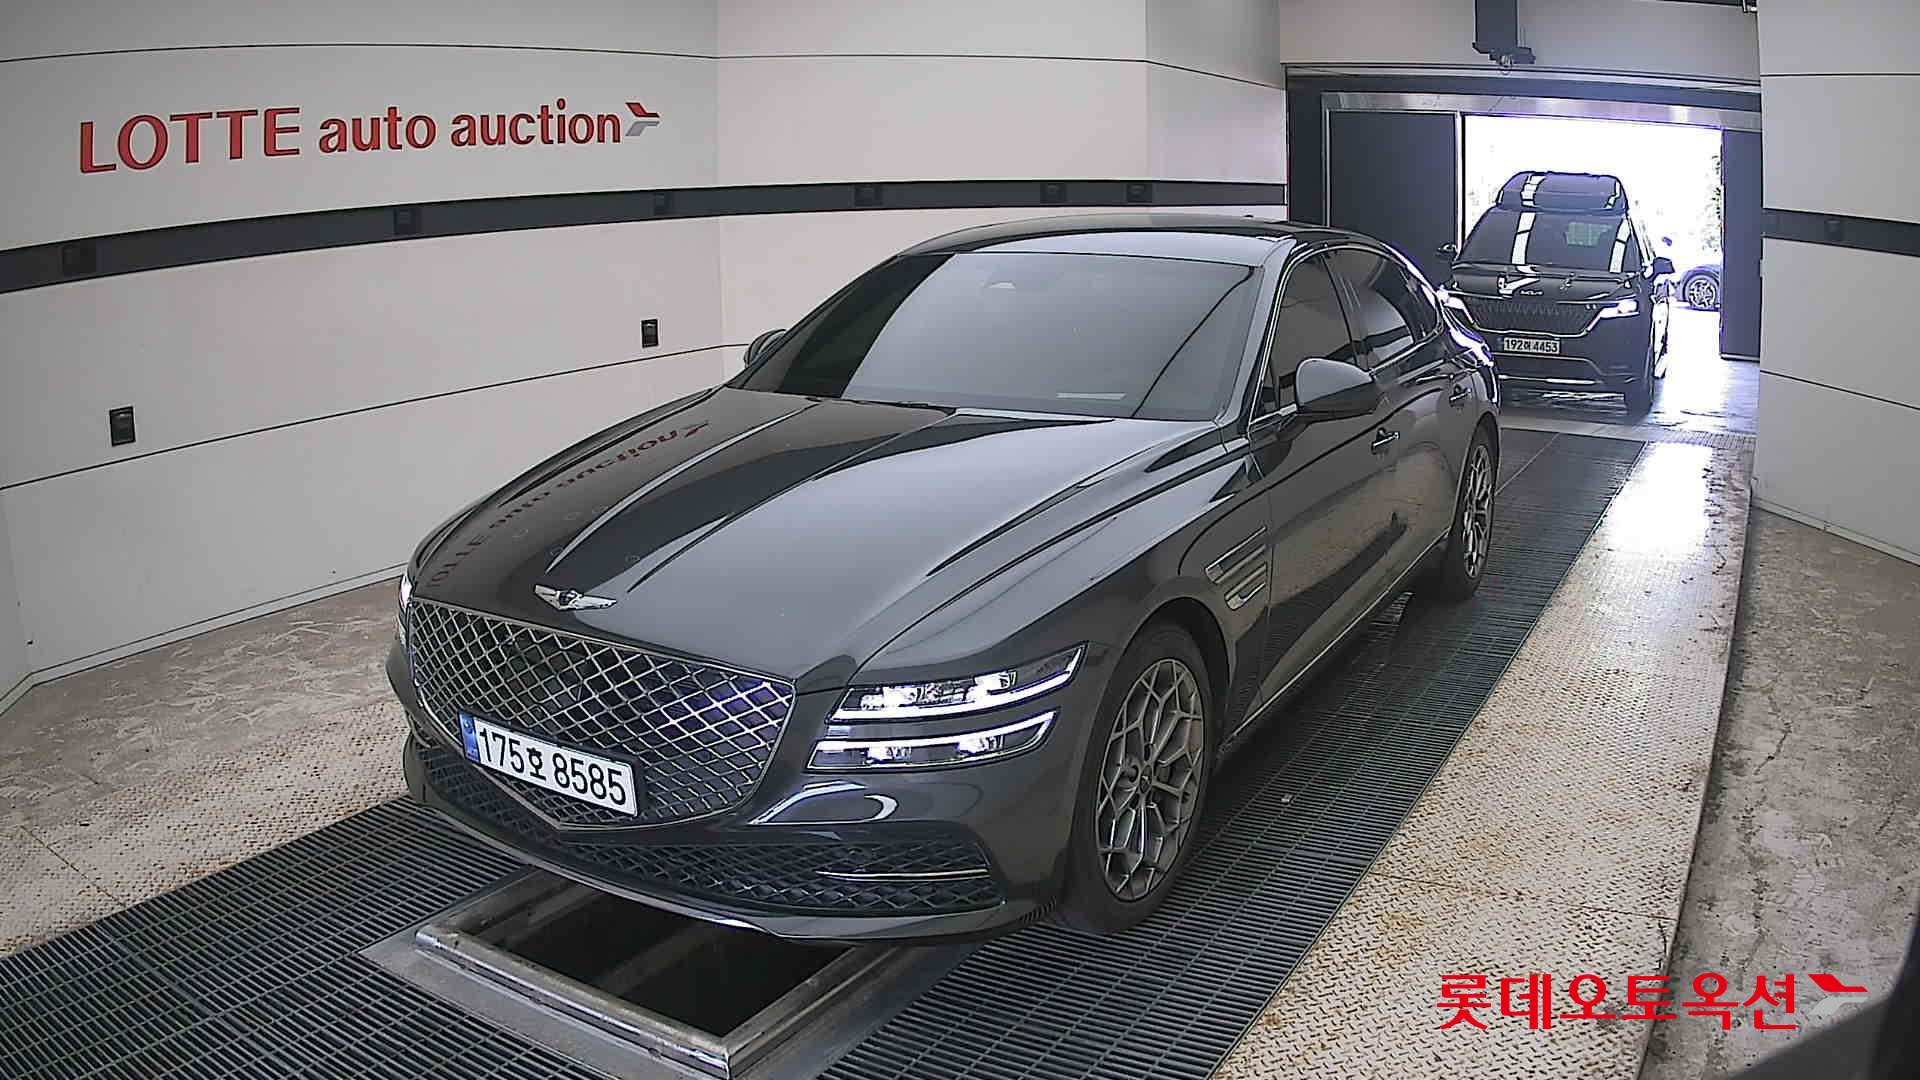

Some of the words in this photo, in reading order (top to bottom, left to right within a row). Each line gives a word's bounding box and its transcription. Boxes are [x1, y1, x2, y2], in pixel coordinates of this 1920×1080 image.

[79, 107, 300, 174] LOTTE
[318, 106, 437, 153] auto
[451, 98, 621, 147] auction
[1533, 340, 1558, 353] 4453
[479, 727, 546, 781] 175호
[553, 753, 626, 806] 8585
